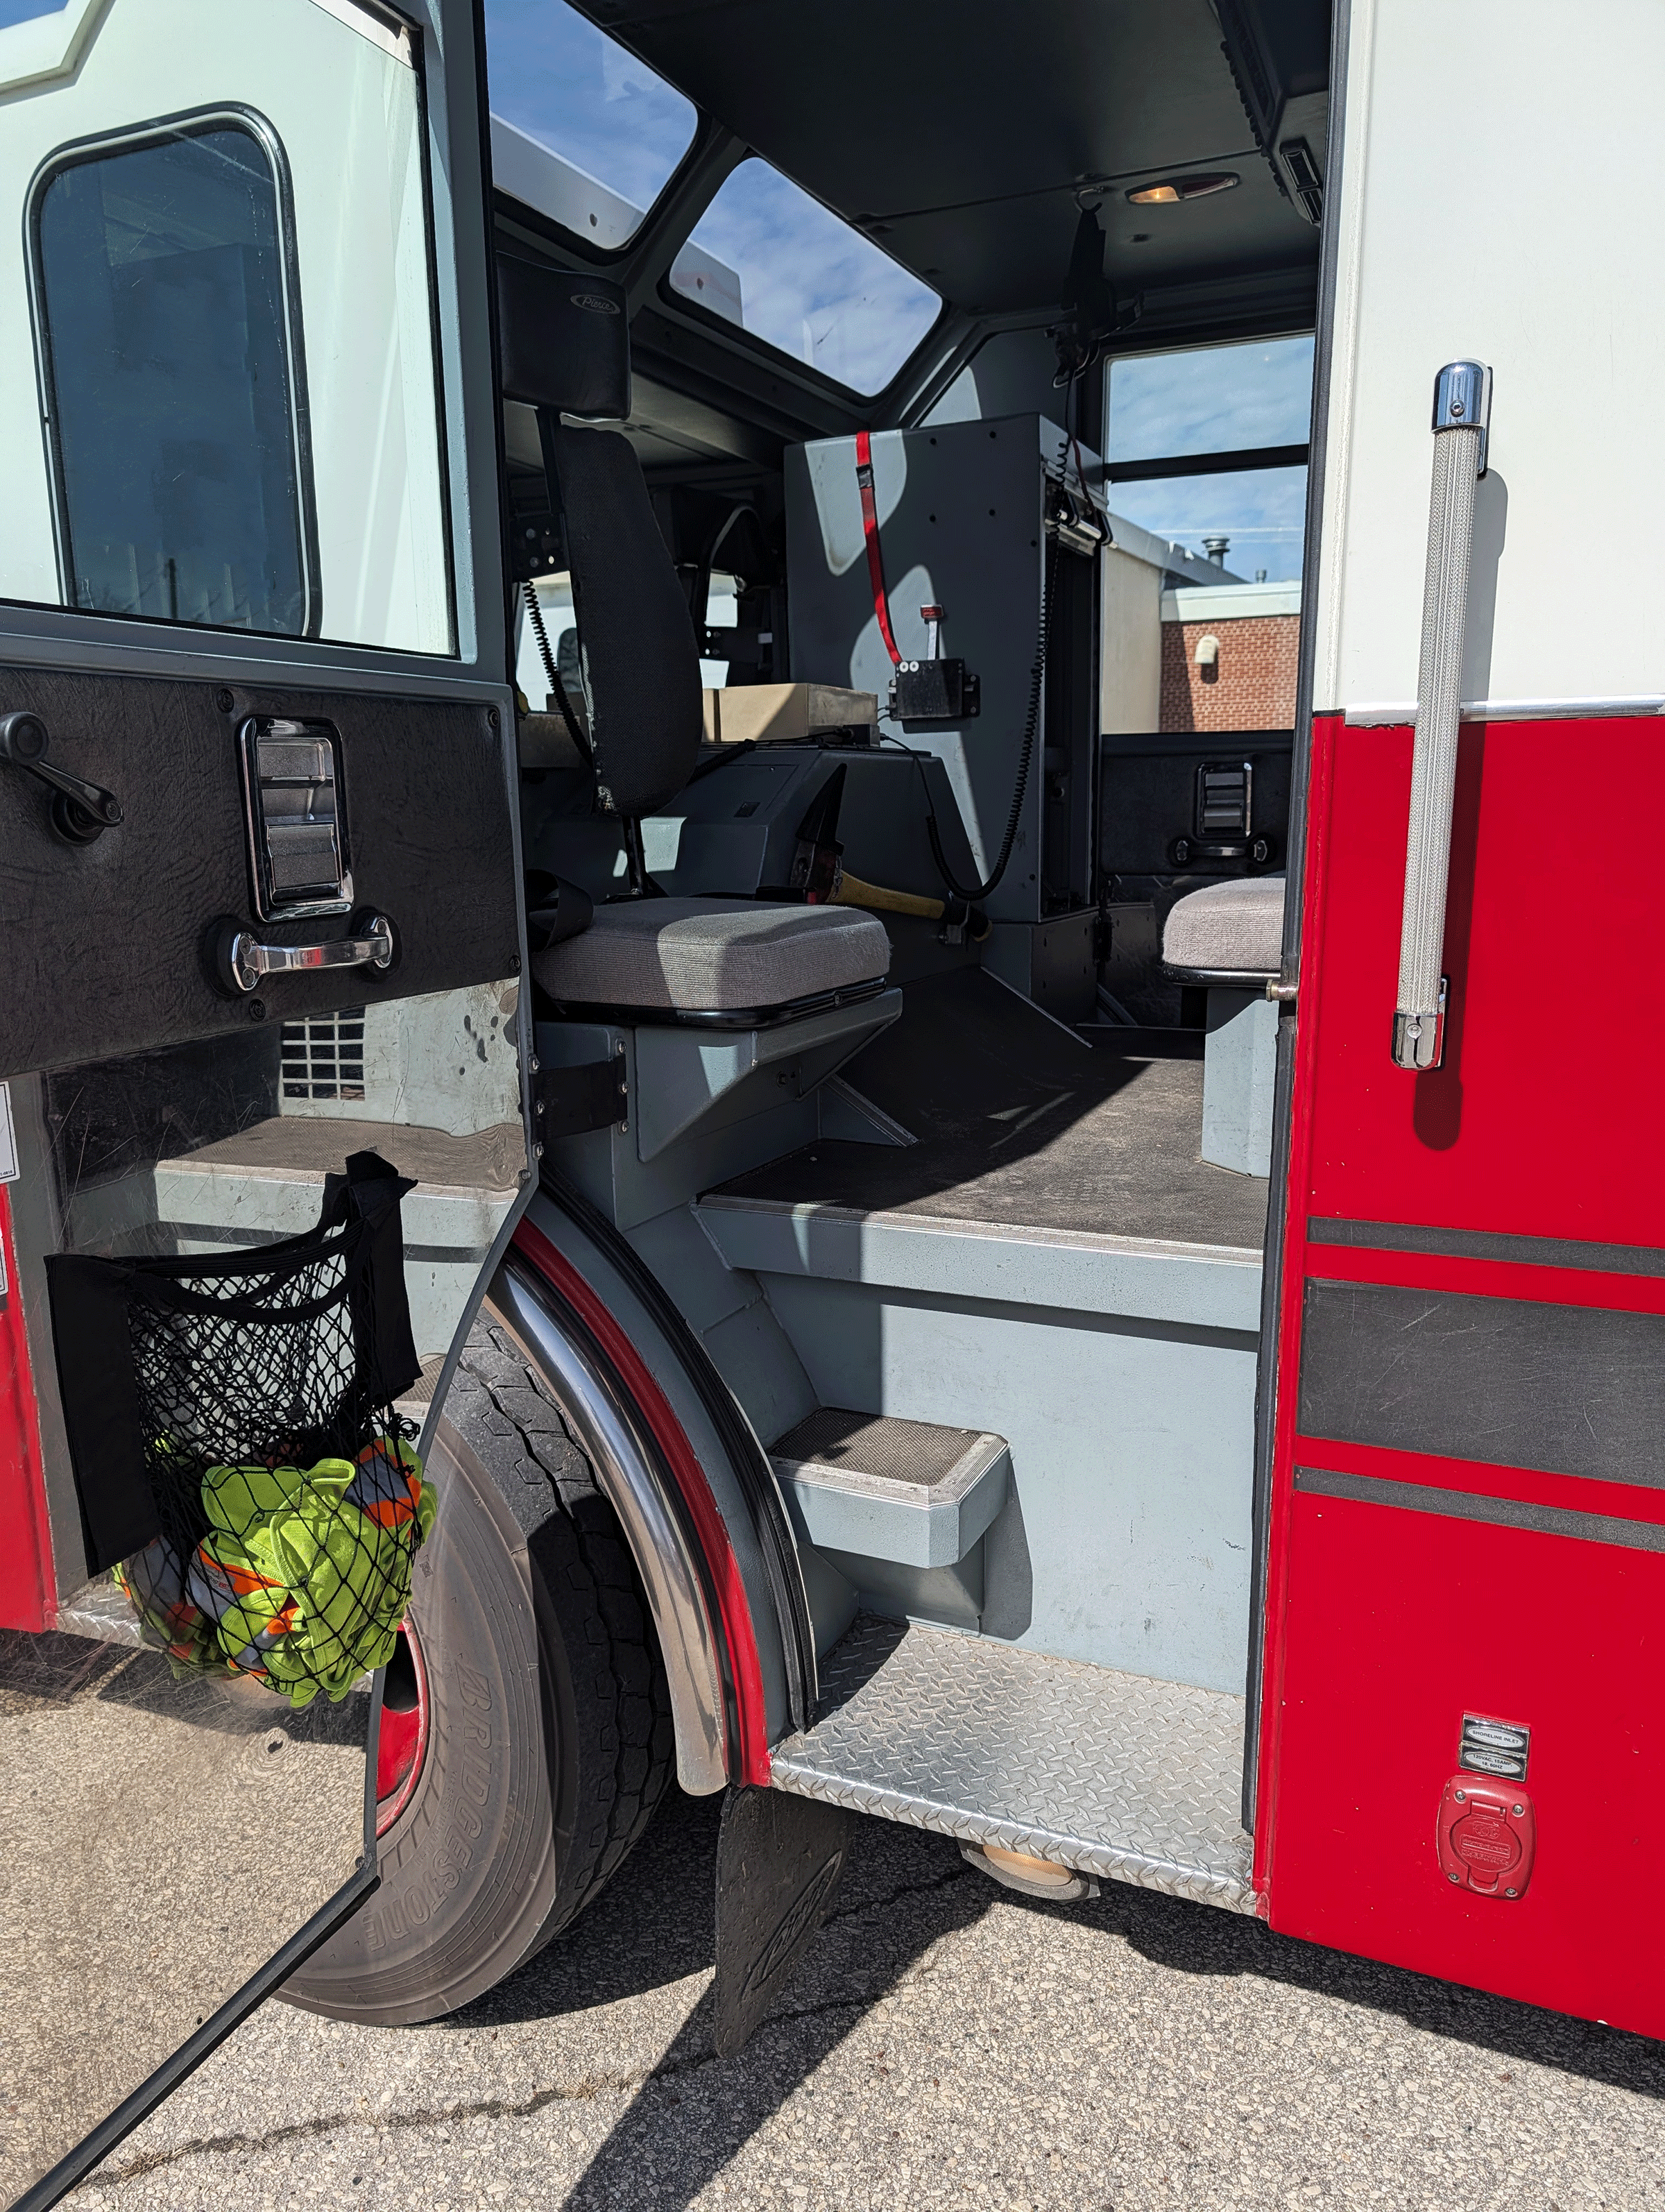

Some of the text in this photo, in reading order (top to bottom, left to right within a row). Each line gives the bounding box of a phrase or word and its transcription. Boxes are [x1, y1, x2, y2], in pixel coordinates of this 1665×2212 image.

[582, 296, 613, 311] Pierce
[1472, 1730, 1503, 1740] SHORELINE
[362, 1666, 493, 1952] BRIDGESTONE
